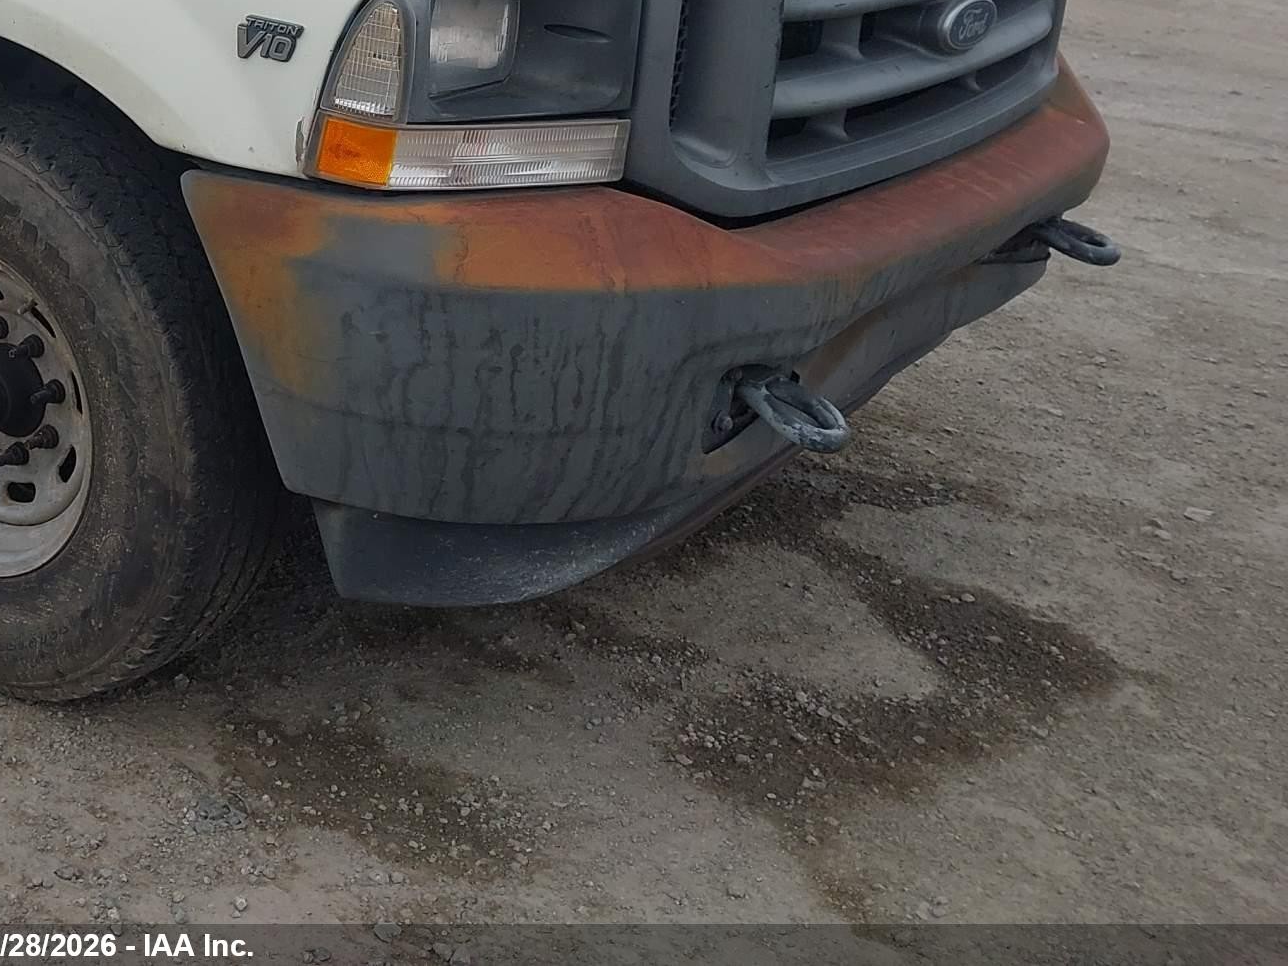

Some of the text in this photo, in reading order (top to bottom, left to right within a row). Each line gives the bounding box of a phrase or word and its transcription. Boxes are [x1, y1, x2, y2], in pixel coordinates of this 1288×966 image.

[246, 16, 299, 36] TRITON
[958, 8, 990, 41] Ford
[237, 24, 295, 62] V10
